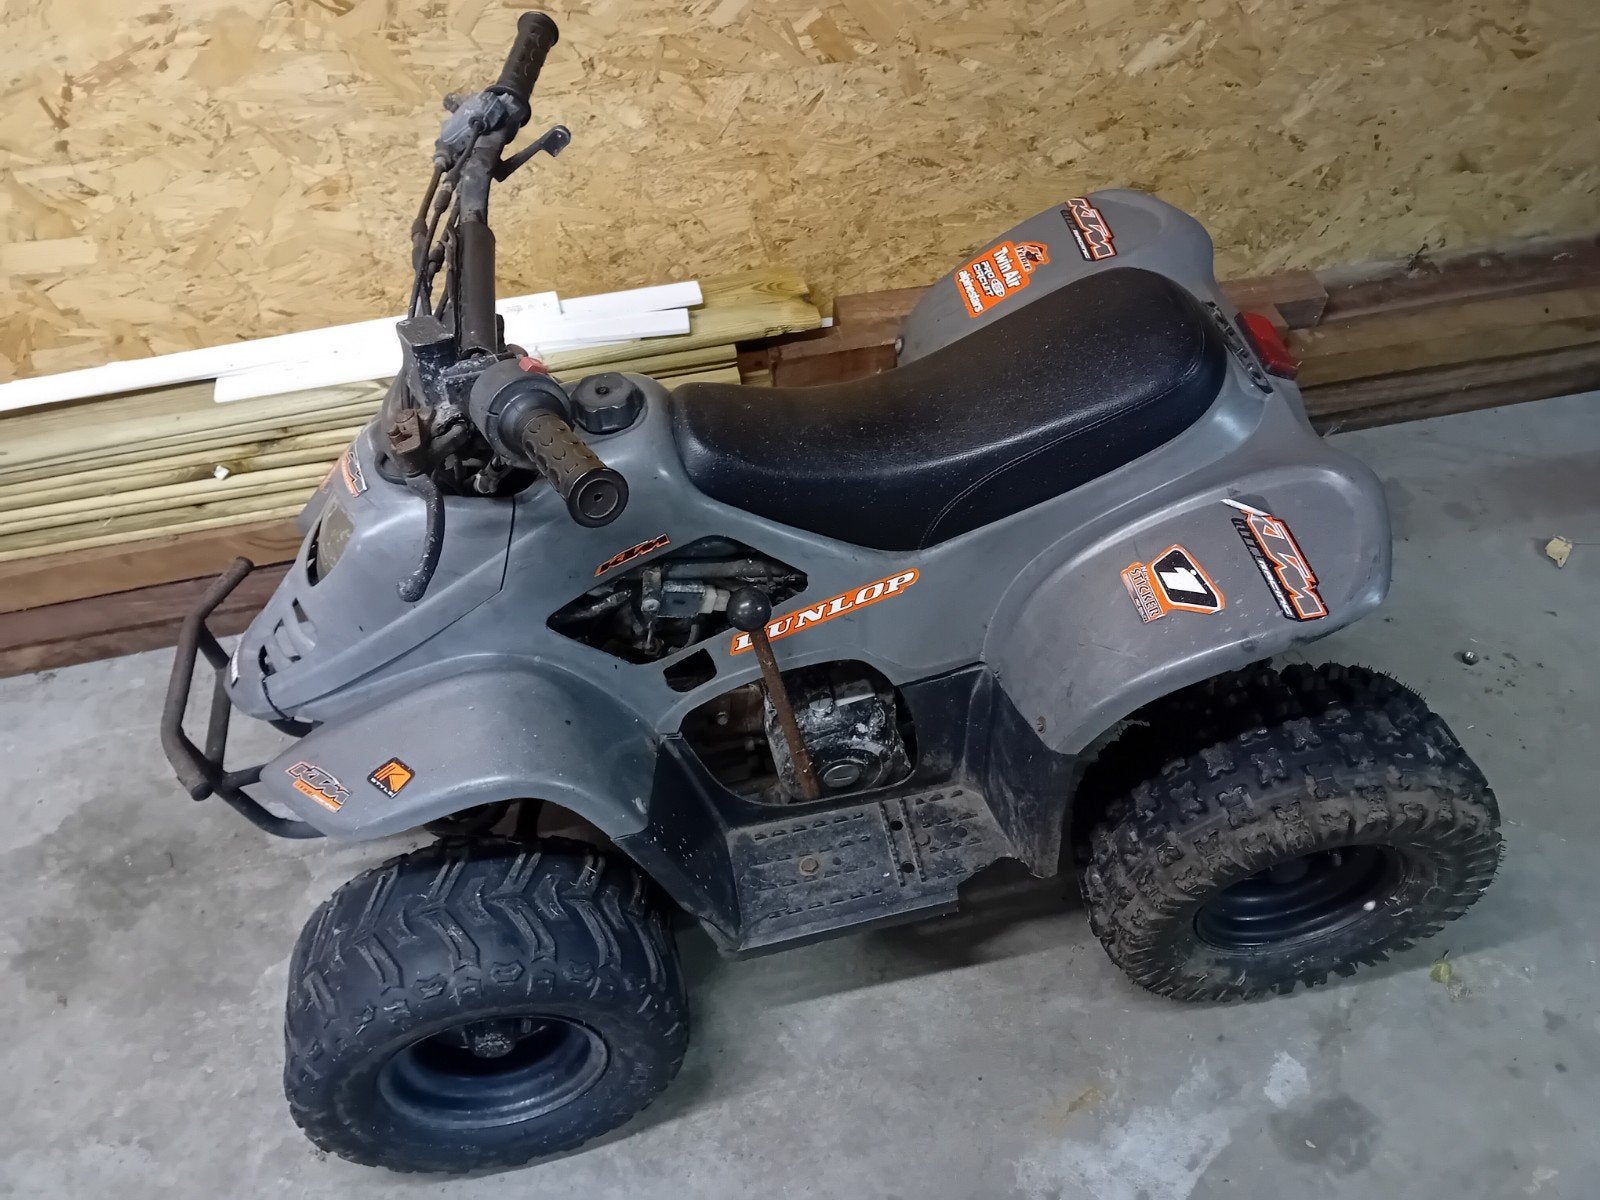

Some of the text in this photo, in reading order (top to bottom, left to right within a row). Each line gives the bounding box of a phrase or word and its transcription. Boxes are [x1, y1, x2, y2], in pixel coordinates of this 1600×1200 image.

[1066, 197, 1116, 261] KTM
[979, 260, 995, 280] PRO
[993, 245, 1013, 272] Twin
[1004, 269, 1022, 288] Air
[958, 270, 983, 313] alpinestars
[1131, 568, 1162, 617] STICKER
[286, 761, 351, 805] KTM
[370, 777, 395, 798] STYLE
